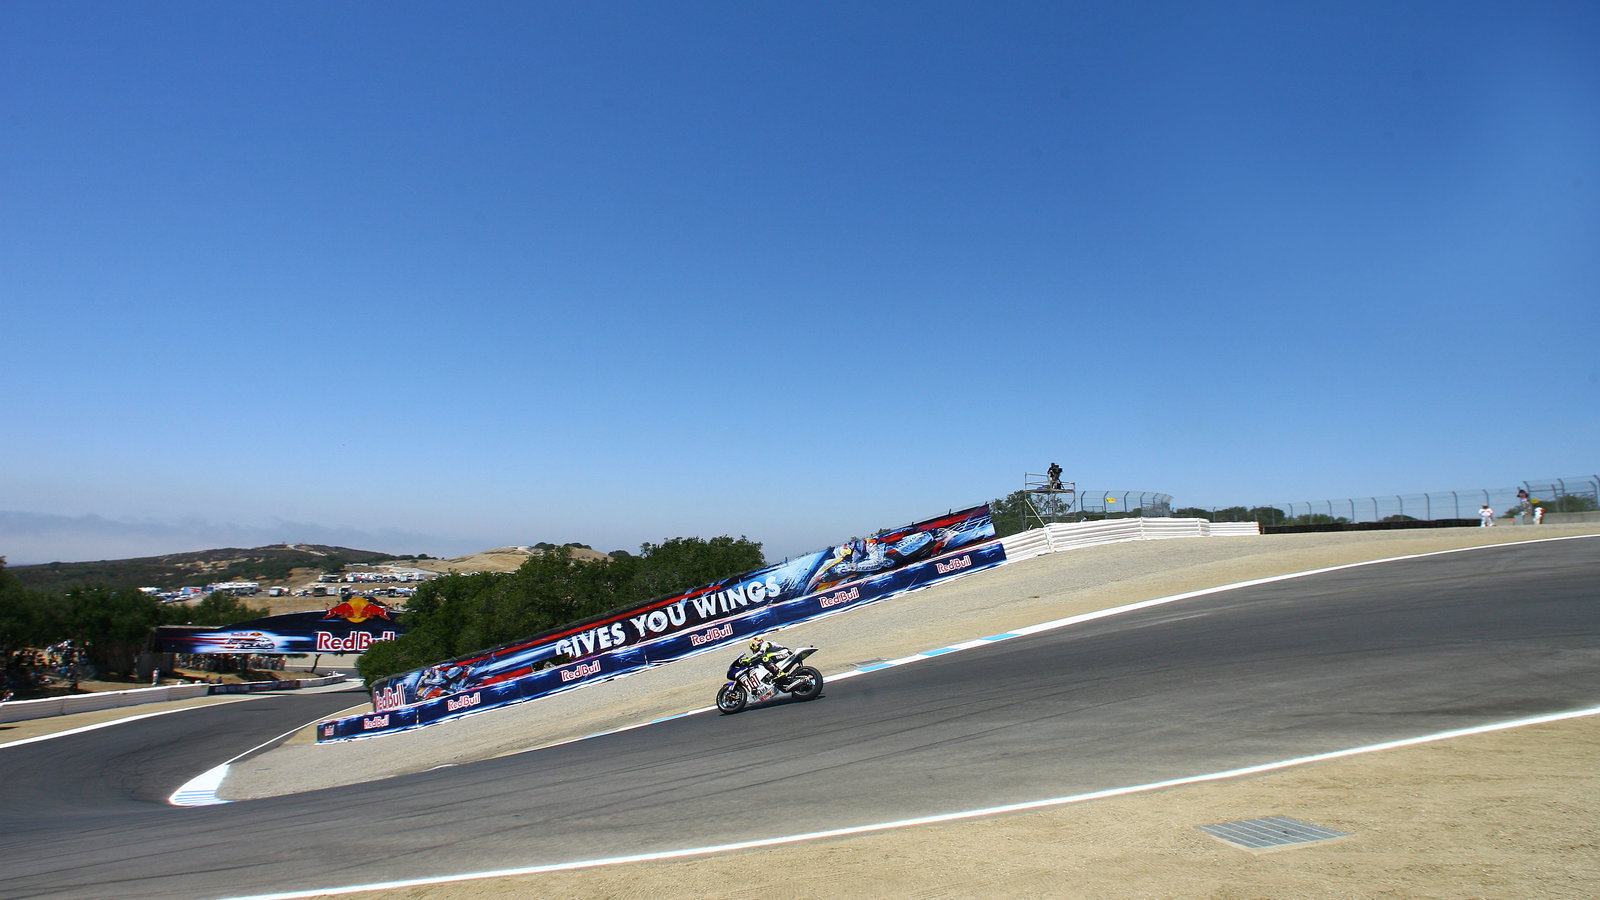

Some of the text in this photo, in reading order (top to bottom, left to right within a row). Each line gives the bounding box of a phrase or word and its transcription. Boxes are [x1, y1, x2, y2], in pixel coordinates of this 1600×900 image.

[555, 576, 781, 658] GIVES YOU WINGS
[742, 673, 761, 693] FIAT
